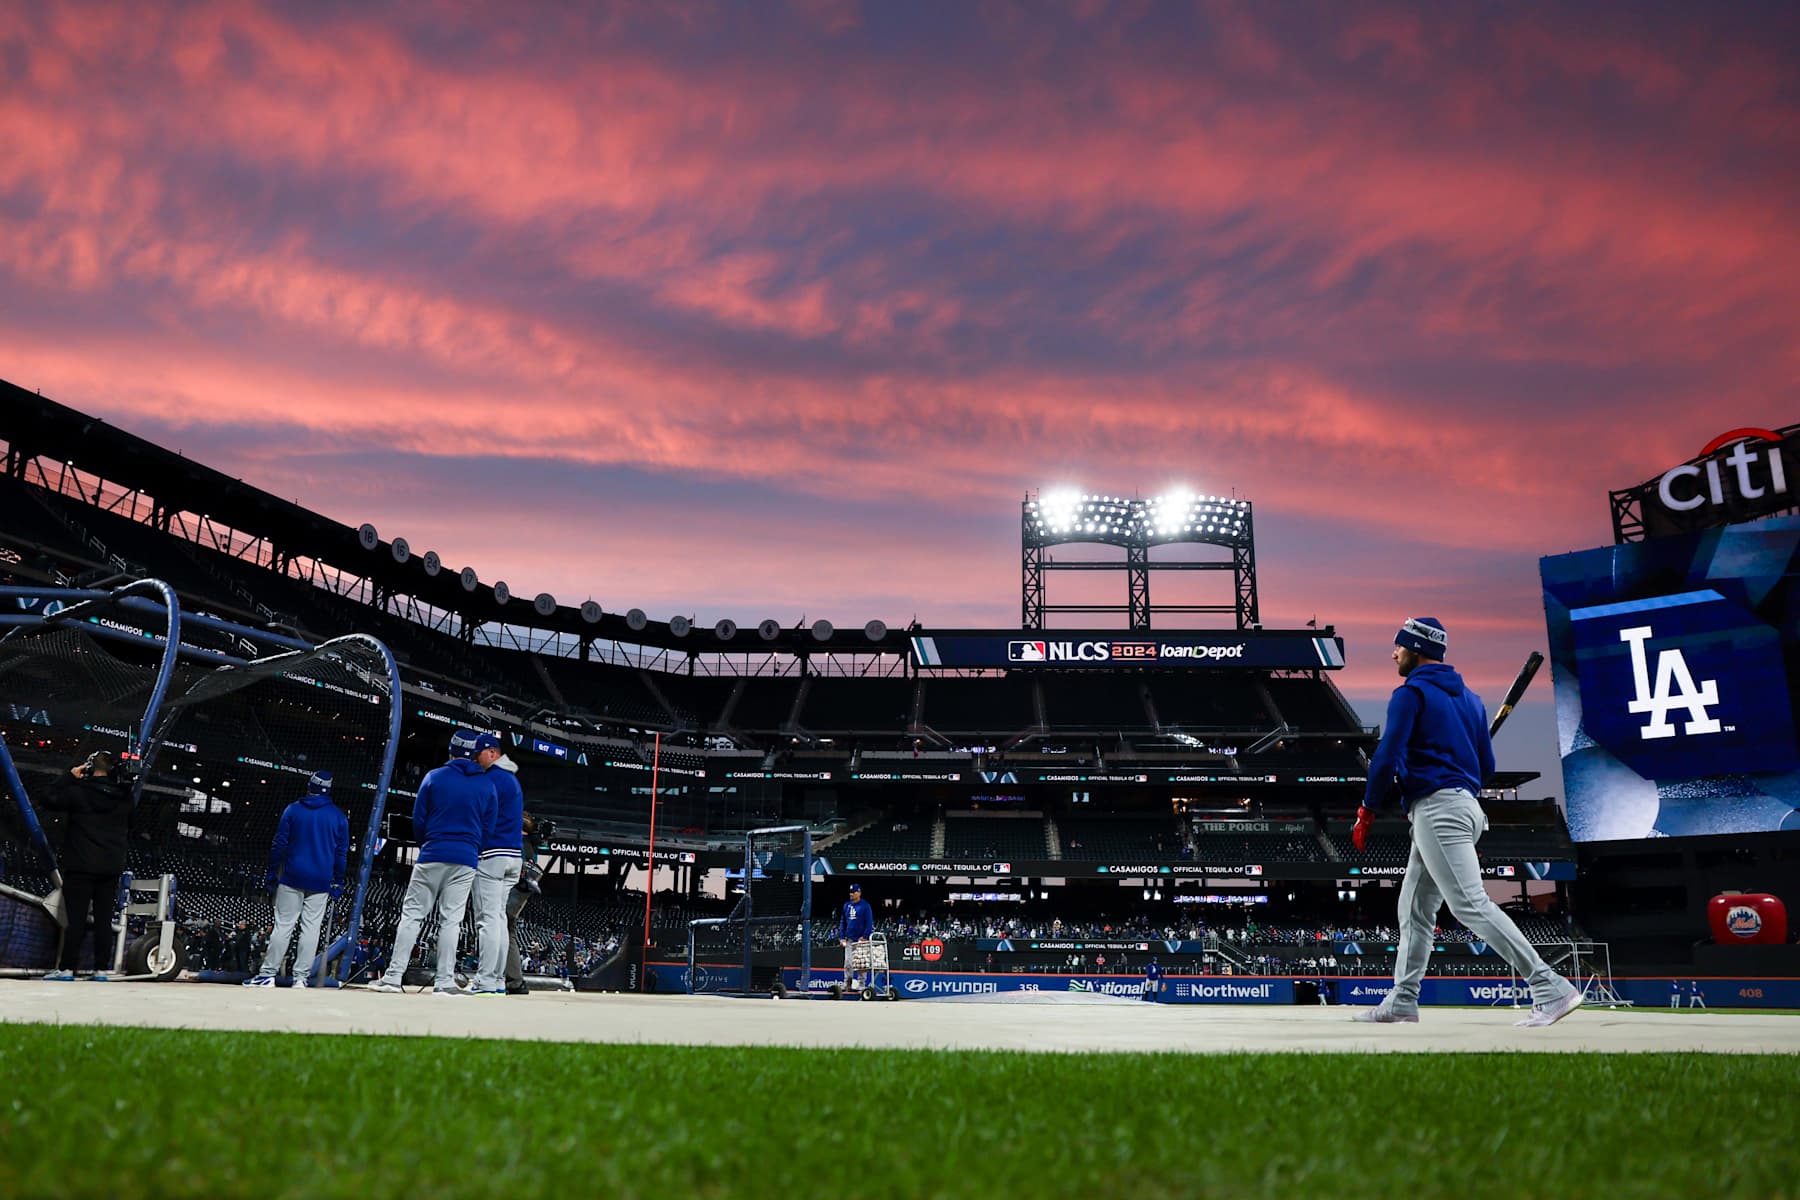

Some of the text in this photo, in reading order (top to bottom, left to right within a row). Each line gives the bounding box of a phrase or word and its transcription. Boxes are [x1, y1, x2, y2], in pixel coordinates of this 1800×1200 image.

[1659, 441, 1787, 511] citi
[426, 556, 437, 570] 24
[100, 618, 144, 637] CASAMIGOS
[1048, 641, 1241, 661] NLCS 2024 loanDepot
[282, 671, 316, 686] CASAMIGOS
[1619, 626, 1721, 739] LA
[425, 711, 451, 723] CASAMIGOS
[92, 724, 129, 738] CASAMIGOS
[244, 756, 273, 768] CASAMIGOS
[612, 761, 644, 770] CASAMIGOS
[1203, 822, 1269, 832] THE PORCH
[551, 843, 598, 855] CASAMIGOS
[612, 848, 641, 857] OFFICIAL
[858, 863, 908, 872] CASAMIGOS
[921, 863, 952, 871] OFFICIAL
[953, 864, 982, 872] TEQUILA
[1109, 865, 1158, 873] CASAMIGOS
[1486, 867, 1496, 875] OF
[932, 981, 997, 993] HYUNDAI
[1019, 984, 1039, 992] 358
[1191, 982, 1269, 998] Northwell
[1738, 987, 1763, 998] 408
